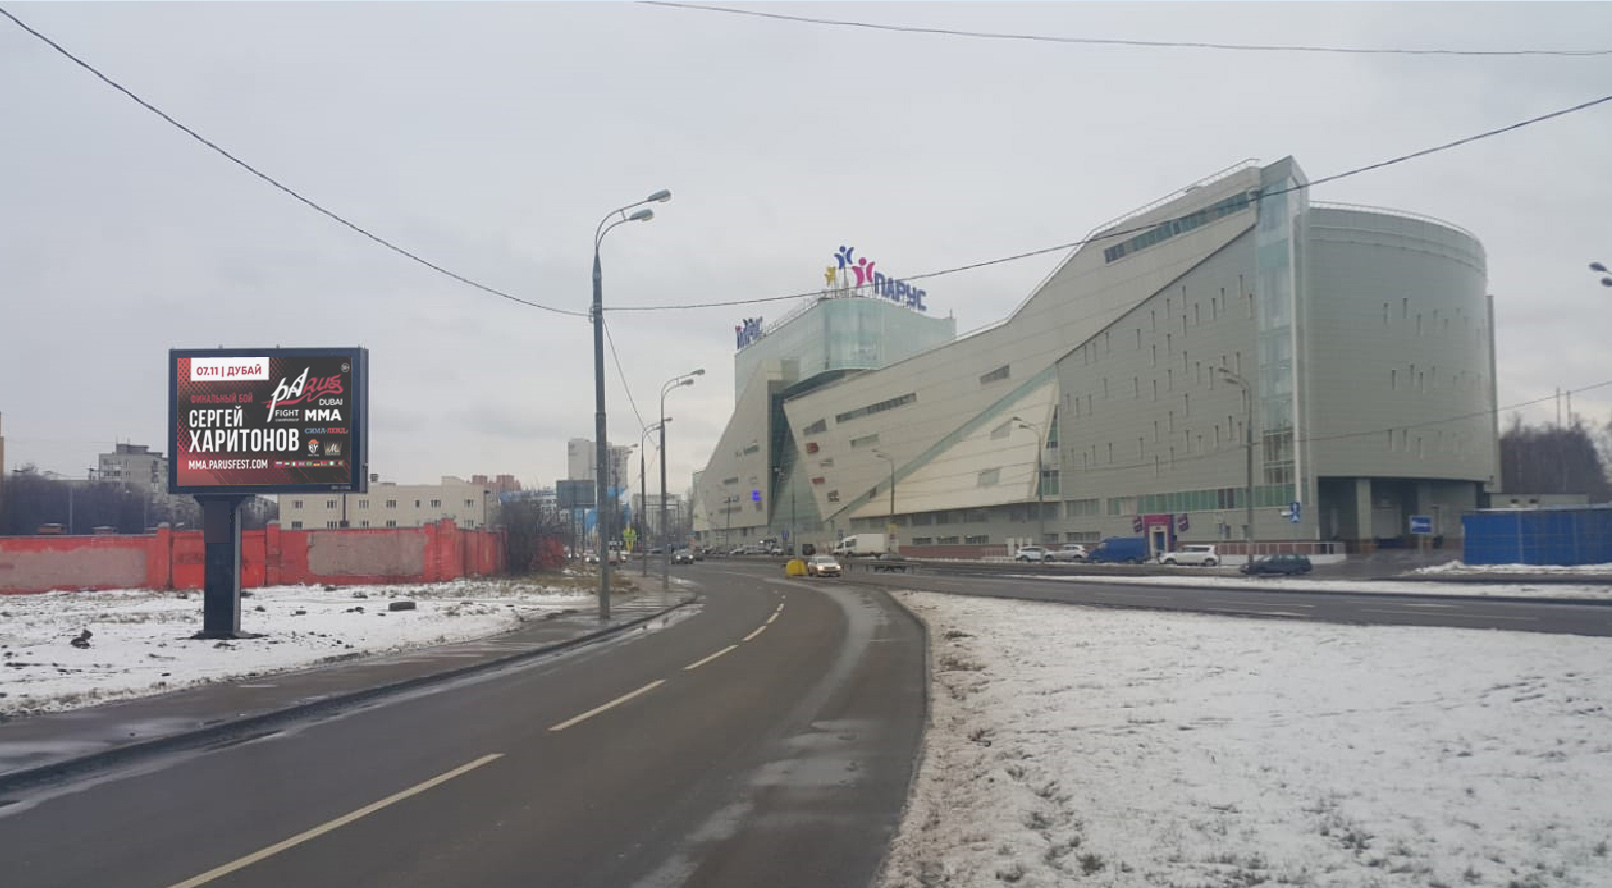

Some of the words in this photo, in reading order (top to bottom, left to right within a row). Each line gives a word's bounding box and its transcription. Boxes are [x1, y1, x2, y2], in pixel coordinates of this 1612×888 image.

[874, 270, 927, 311] ПАРУС
[196, 366, 219, 376] 07.11
[227, 363, 262, 377] ДУБАЙ
[190, 393, 237, 404] ФИНАЛЬНЫЙ
[238, 393, 253, 404] БОЙ
[319, 398, 343, 406] DUBAI
[189, 406, 243, 428] СЕРГЕЙ
[274, 409, 300, 417] FIGHT
[304, 409, 342, 422] MMA
[189, 428, 300, 453] ХАРИТОНОВ
[188, 459, 268, 470] MMA.PARUSFEST.COM
